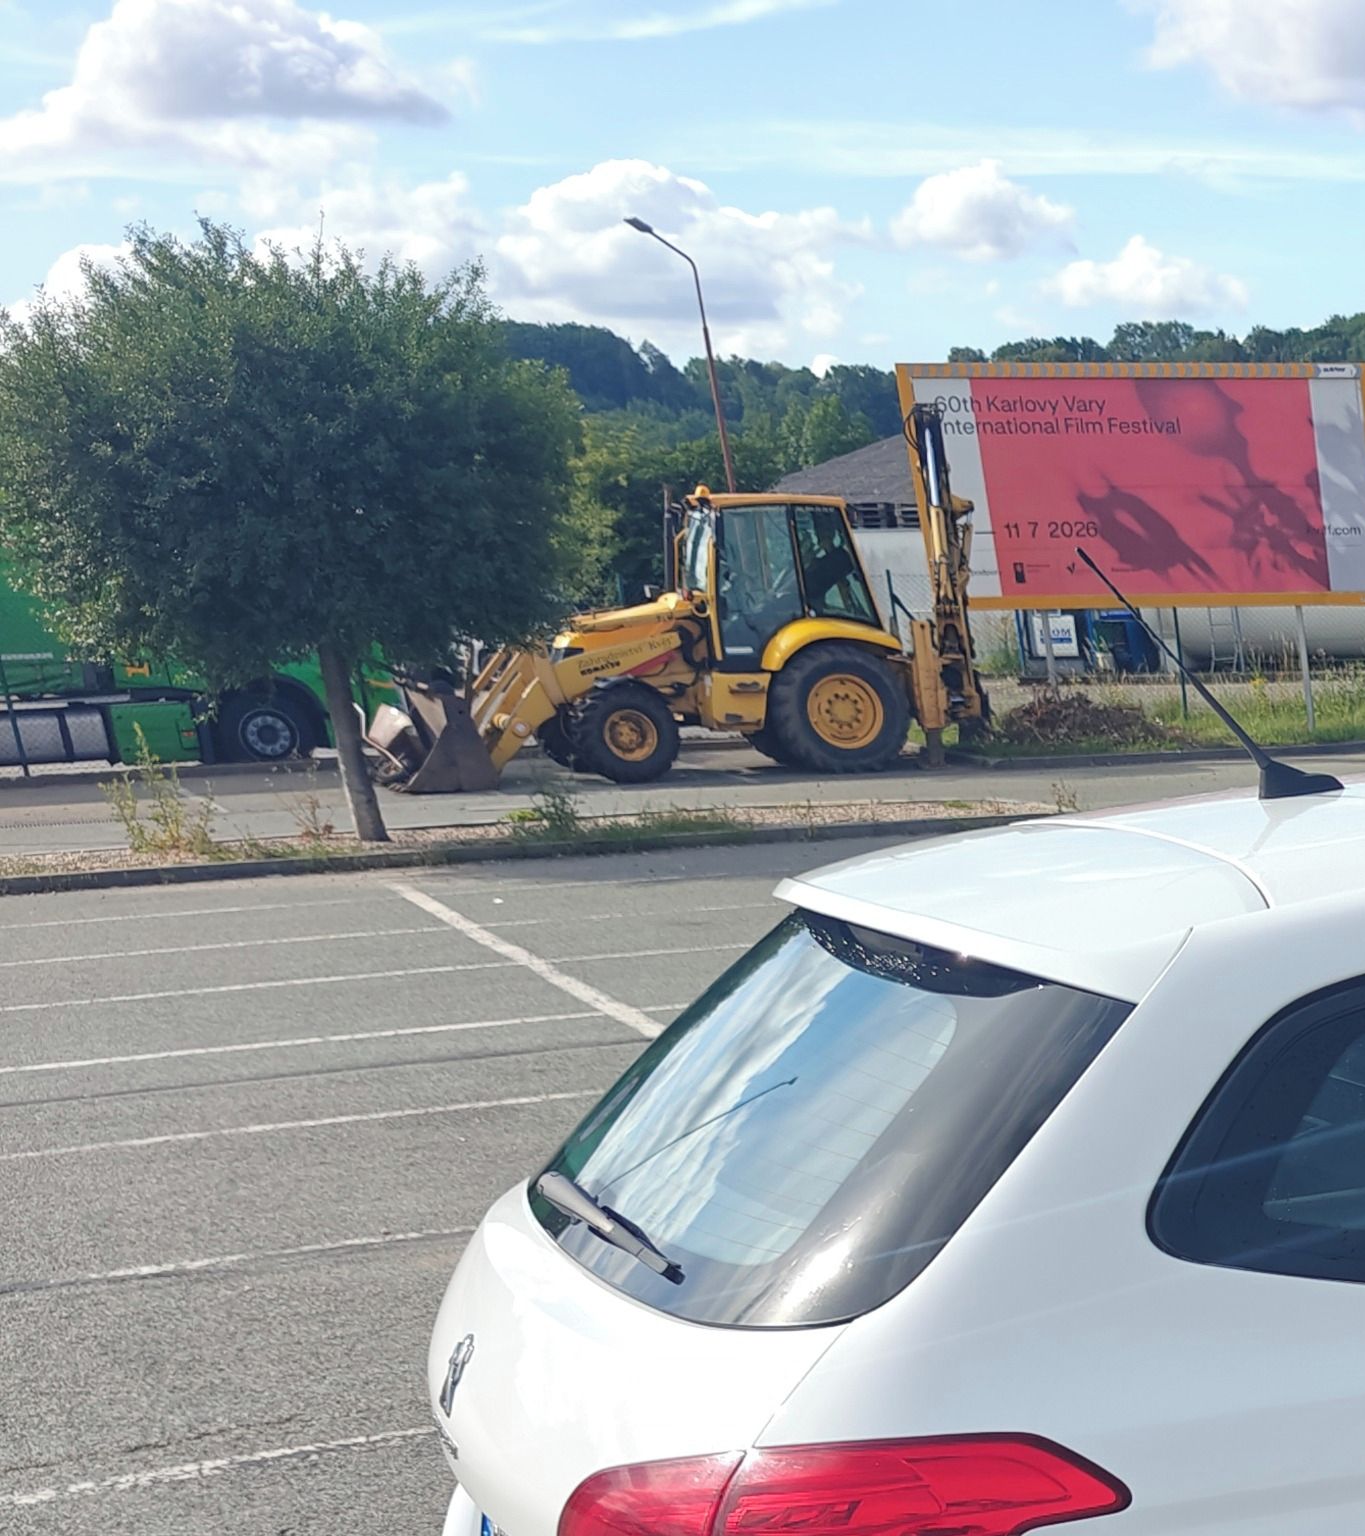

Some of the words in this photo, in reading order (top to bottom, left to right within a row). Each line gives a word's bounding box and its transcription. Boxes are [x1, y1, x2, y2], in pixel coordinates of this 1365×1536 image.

[934, 395, 982, 413] 60th
[986, 395, 1059, 416] Karlovy
[1062, 395, 1106, 416] Vary
[942, 418, 1060, 435] nternational
[1064, 417, 1103, 435] Film
[1107, 416, 1182, 435] Festival
[1004, 522, 1020, 539] 11
[1027, 522, 1039, 539] 7
[1048, 521, 1099, 538] 2026
